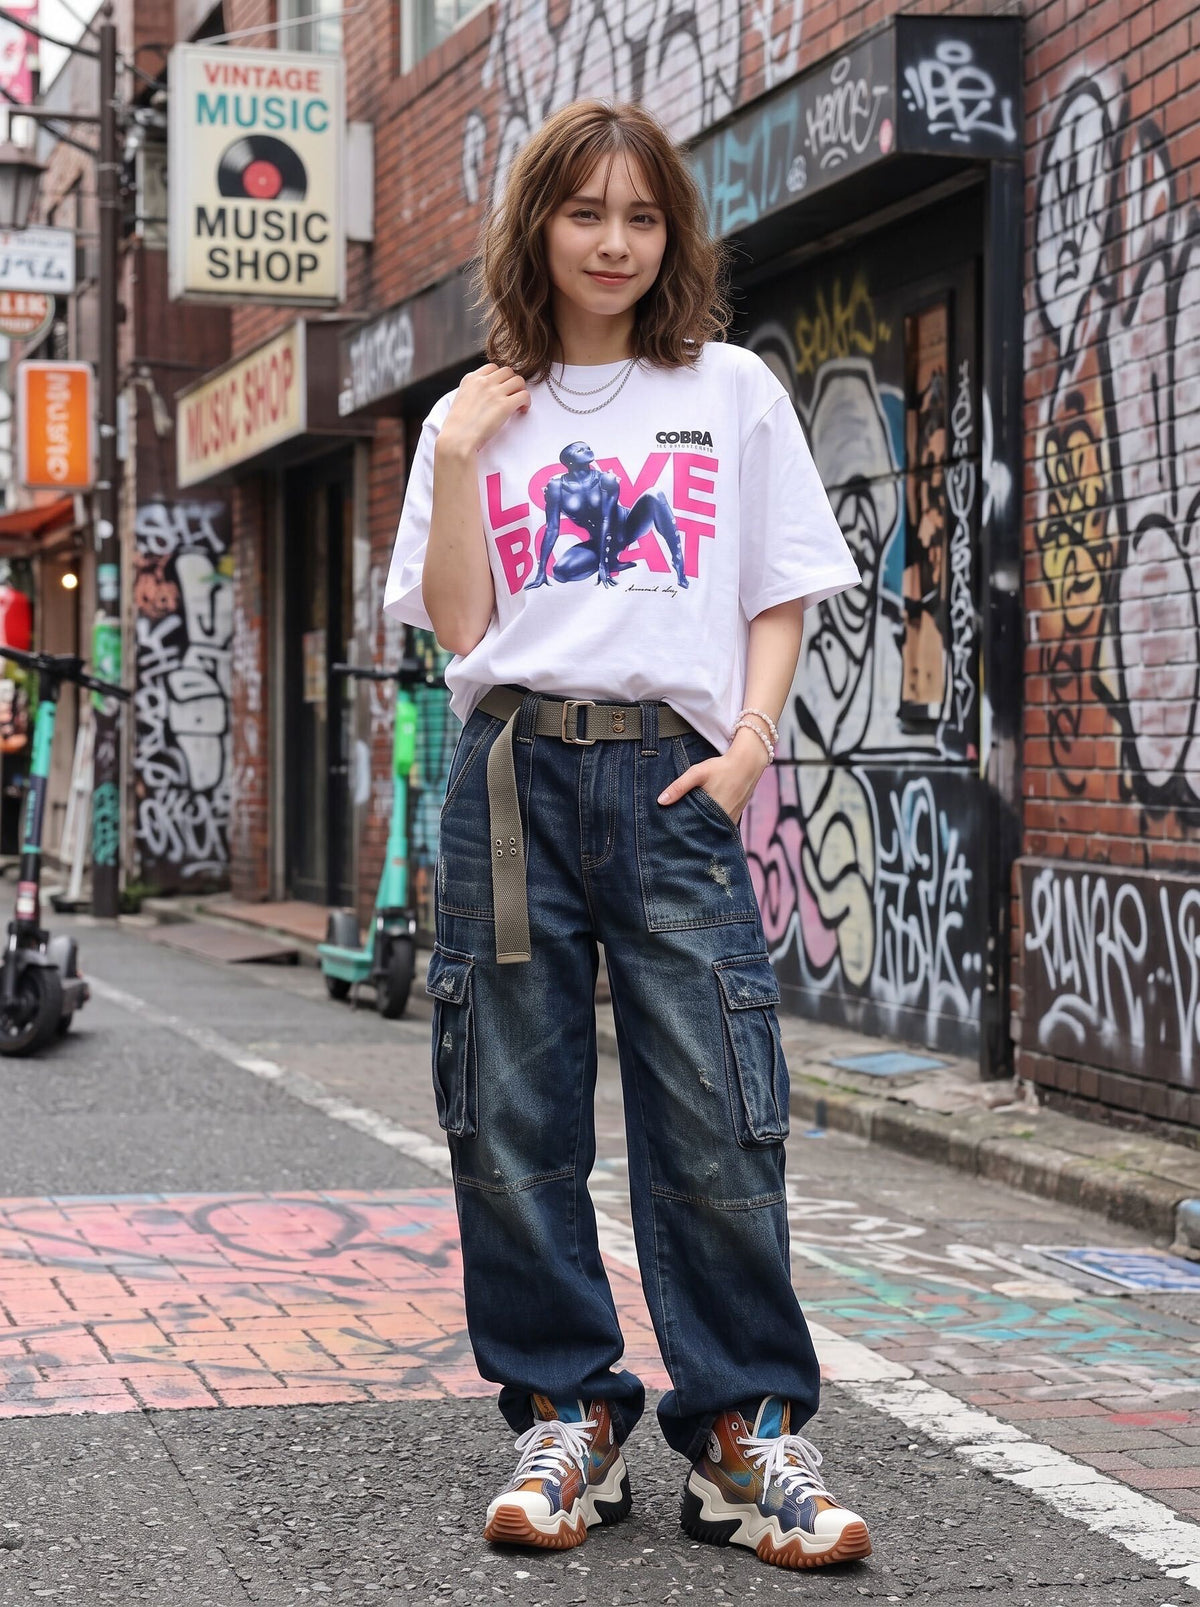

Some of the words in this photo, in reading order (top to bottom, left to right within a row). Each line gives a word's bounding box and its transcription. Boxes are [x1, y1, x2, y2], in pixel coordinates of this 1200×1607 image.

[204, 63, 321, 92] VINTAGE
[196, 93, 329, 133] MUSIC
[196, 206, 328, 244] MUSIC
[208, 247, 318, 283] SHOP
[187, 379, 237, 465] MUSIC
[243, 346, 293, 437] SHOP
[655, 431, 714, 447] COBRA
